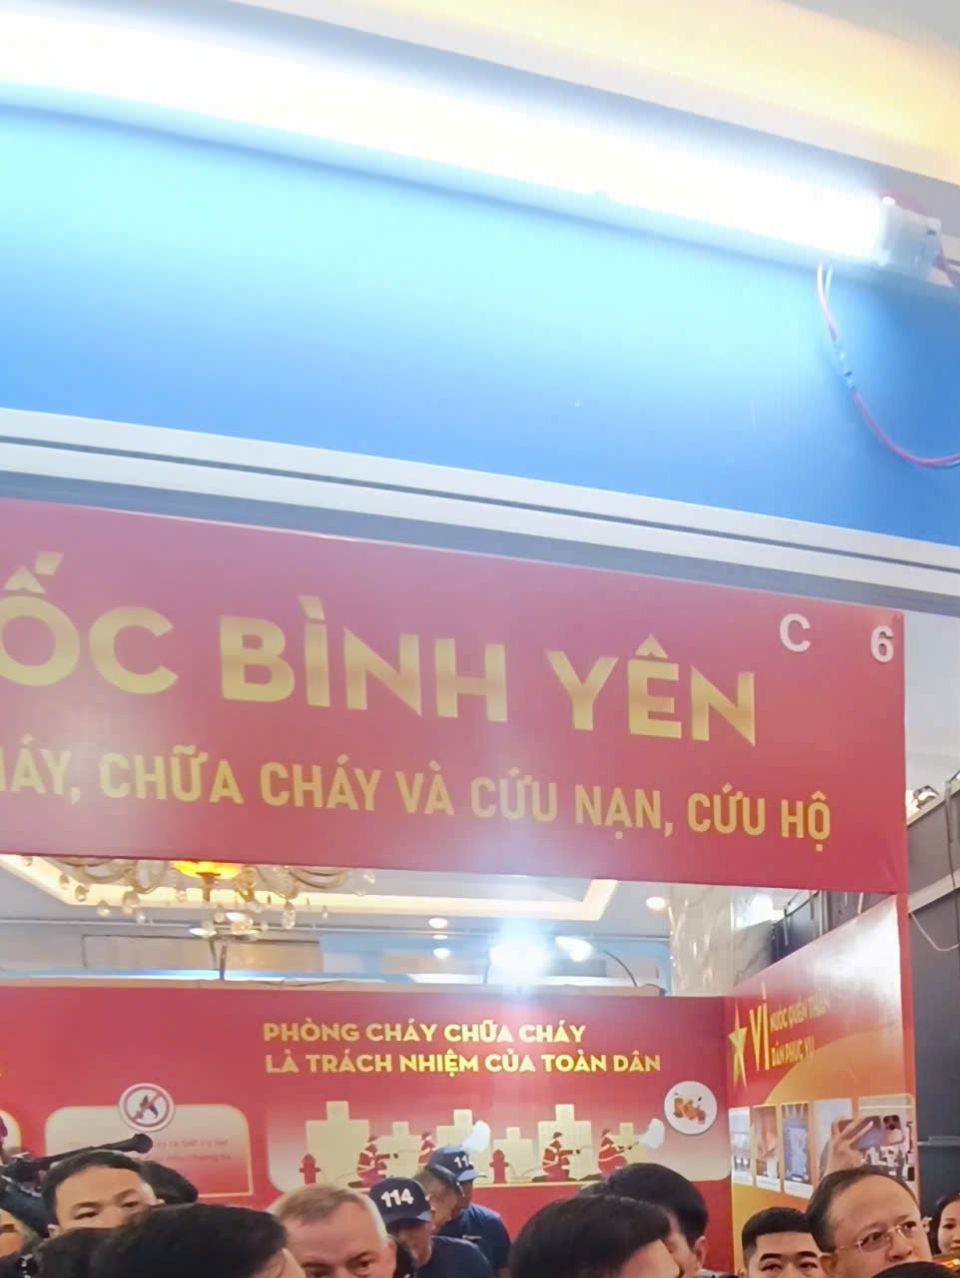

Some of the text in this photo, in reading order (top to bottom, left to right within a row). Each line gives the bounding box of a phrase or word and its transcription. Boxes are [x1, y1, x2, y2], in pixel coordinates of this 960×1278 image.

[779, 613, 895, 663] C 6
[219, 595, 508, 723] BÌNH
[546, 632, 756, 747] YÊN
[100, 744, 244, 804] CHỮA
[260, 753, 382, 812] CHÁY
[395, 760, 456, 817] VÀ
[470, 766, 557, 822] CỨU
[574, 783, 673, 840] NẠN,
[687, 783, 765, 836] CỨU
[780, 789, 831, 852] HỘ
[263, 1017, 586, 1043] PHÒNG CHÁY CHỮA CHÁY
[265, 1047, 661, 1077] LÀ TRÁCH NHIỆM CỦA TOÀN DÂN
[381, 1188, 414, 1208] 114
